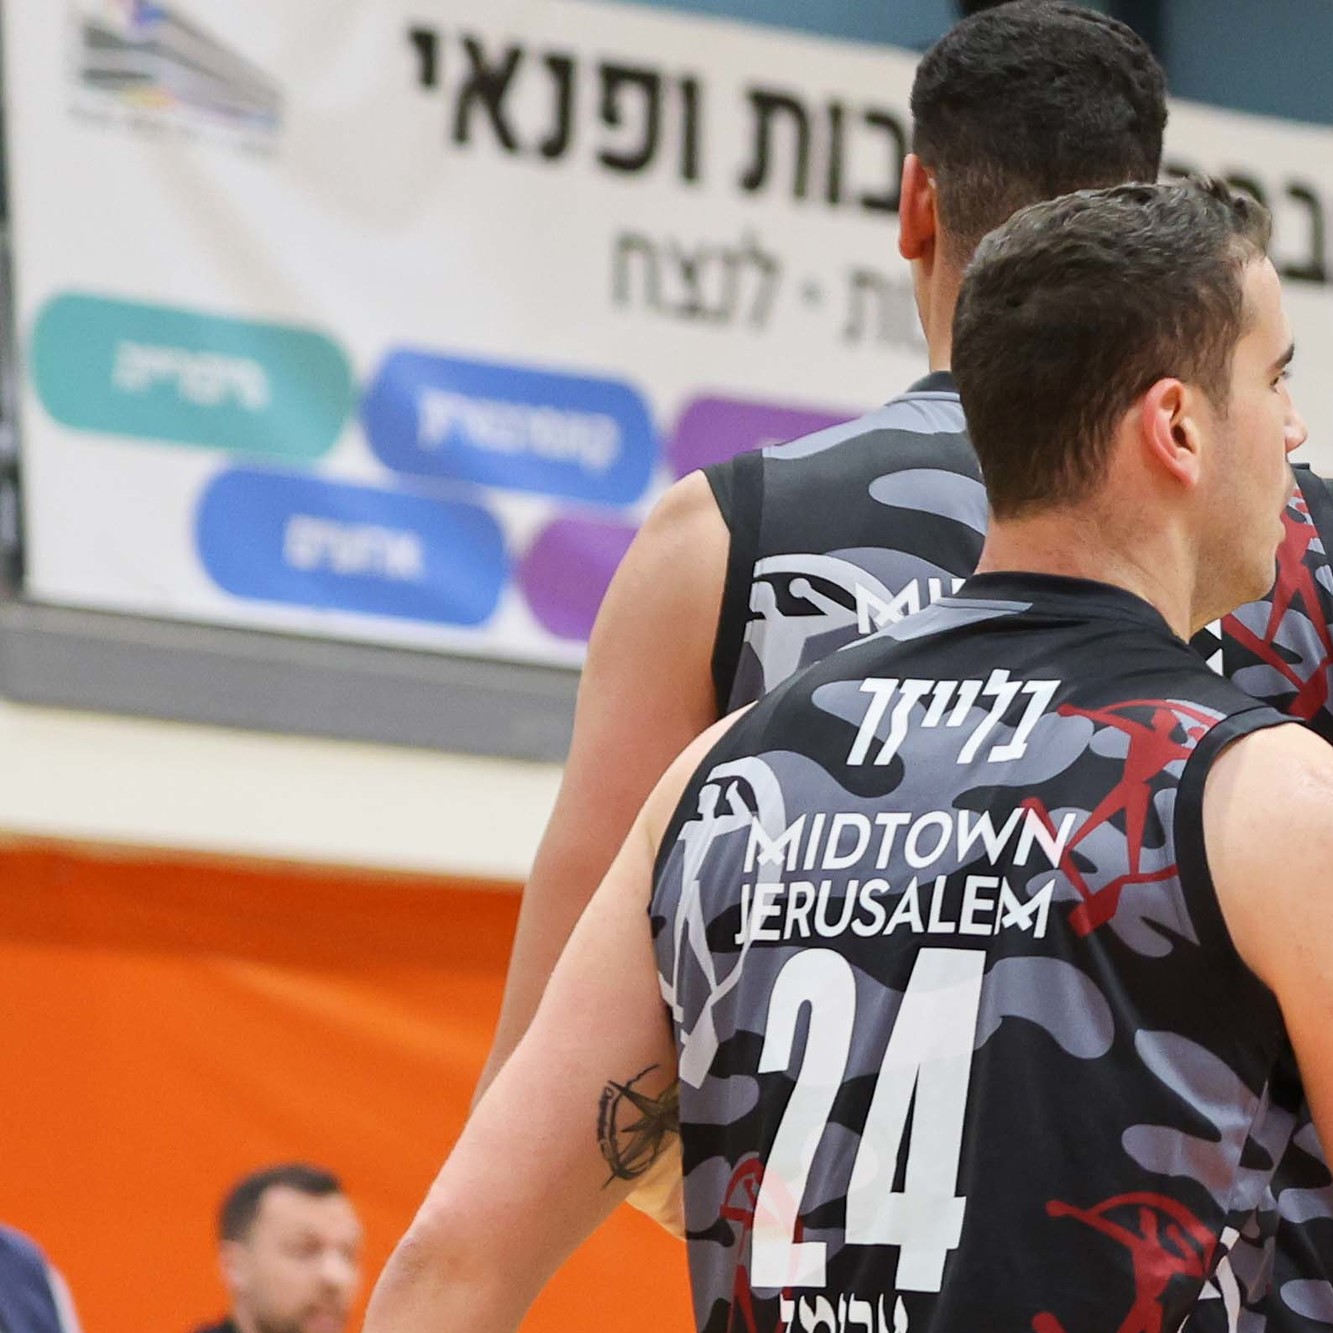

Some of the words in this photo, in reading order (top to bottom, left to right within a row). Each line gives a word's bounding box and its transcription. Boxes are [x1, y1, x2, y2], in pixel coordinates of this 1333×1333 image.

[409, 26, 703, 184] ופנאי
[613, 228, 782, 331] לנצח
[846, 668, 1062, 766] בלייזר
[743, 807, 1077, 873] MIDTOWN
[734, 874, 1056, 945] JERUSALEM
[751, 947, 986, 1292] 24
